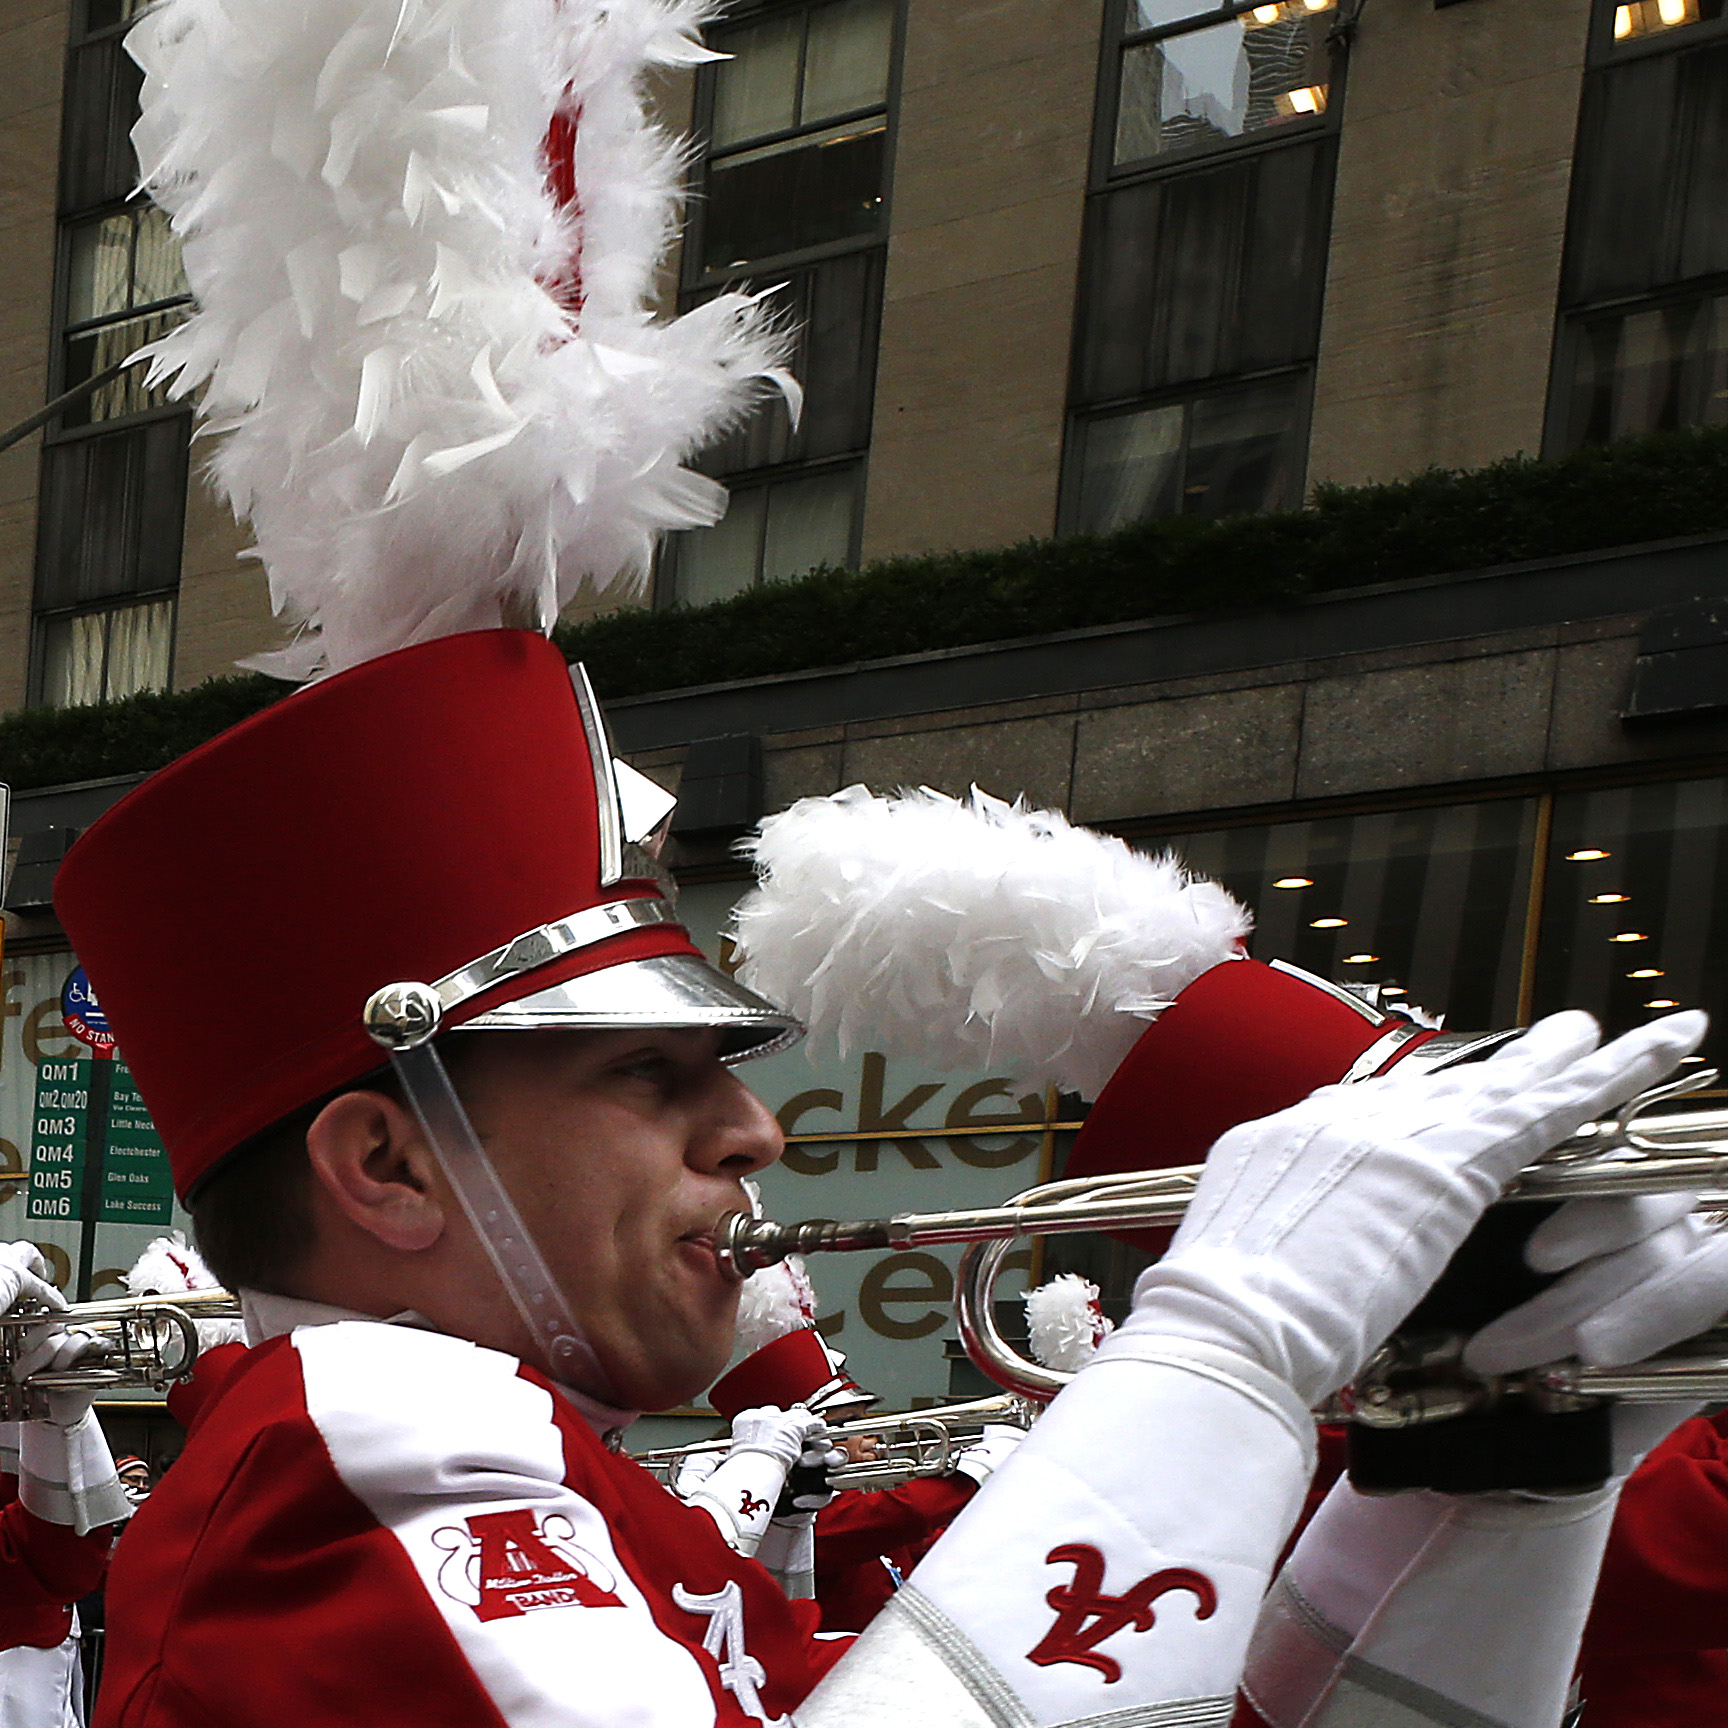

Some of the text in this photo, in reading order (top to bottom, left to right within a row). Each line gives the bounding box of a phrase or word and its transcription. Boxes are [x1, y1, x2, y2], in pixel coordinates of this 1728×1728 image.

[69, 1018, 85, 1034] NO
[42, 1062, 78, 1081] QM1
[113, 1091, 128, 1103] Bay
[37, 1116, 76, 1135] QM3
[111, 1119, 132, 1129] Little
[36, 1144, 74, 1162] QM4
[34, 1170, 72, 1189] QM5
[107, 1172, 149, 1183] Glen Oaks
[32, 1197, 70, 1216] QM6
[105, 1199, 161, 1211] Lake Success
[515, 1591, 576, 1607] BAND
